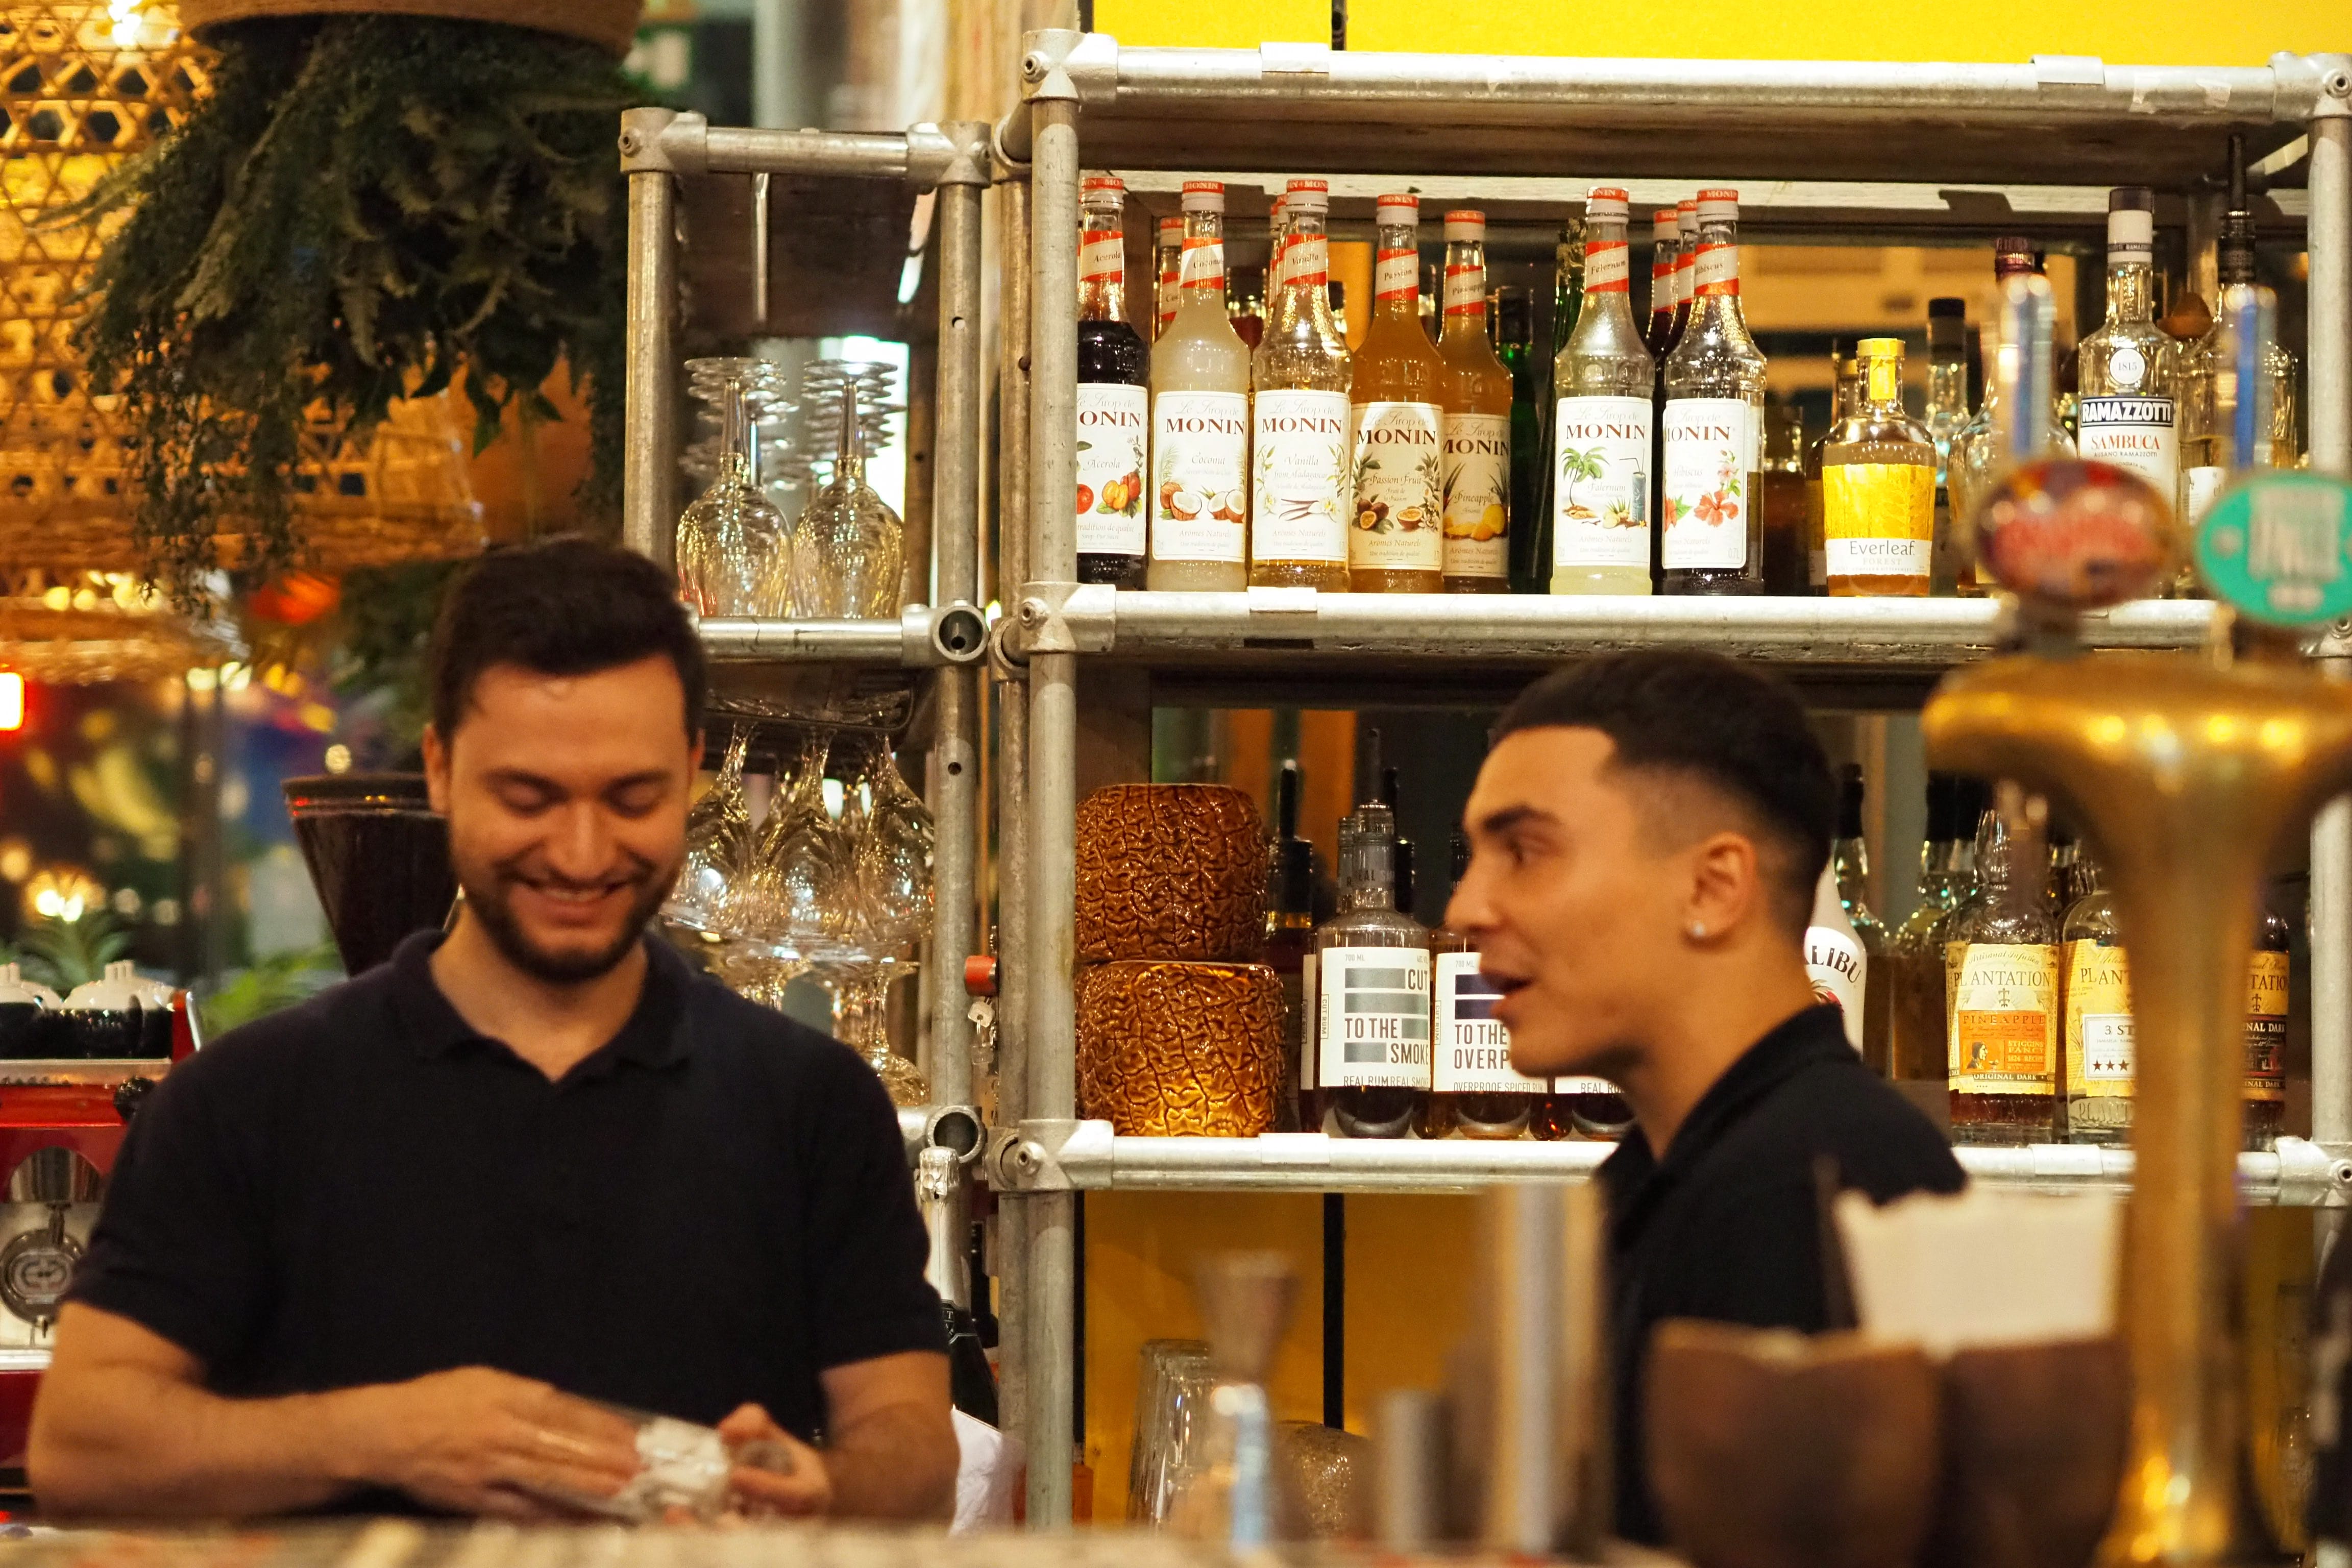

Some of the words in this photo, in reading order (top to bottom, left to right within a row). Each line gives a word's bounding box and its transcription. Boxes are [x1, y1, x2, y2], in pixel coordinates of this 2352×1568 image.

[1094, 251, 1121, 263] Acerola
[1292, 253, 1319, 265] Vanilla
[1384, 268, 1412, 281] Passion
[1590, 260, 1626, 275] Falernum
[1452, 283, 1484, 296] Pineapp
[2118, 362, 2137, 371] 1815
[1090, 392, 1121, 410] Sirop
[1269, 399, 1287, 414] Le
[1289, 398, 1320, 417] Sirop
[1324, 406, 1336, 414] de
[1175, 400, 1194, 414] Le
[1196, 400, 1227, 419] Sirop
[1229, 407, 1239, 415] de
[1574, 405, 1591, 421] Le
[1594, 404, 1626, 423] Sirop
[1629, 412, 1639, 421] de
[2082, 402, 2171, 422] RAMAZZOTTI
[1080, 410, 1141, 428] ONIN
[1166, 418, 1245, 435] MONIN
[1262, 417, 1342, 434] MONIN
[1365, 411, 1381, 426] Le
[1384, 410, 1415, 429] Sirop
[1418, 418, 1429, 426] de
[1357, 428, 1436, 446] MONIN
[1445, 422, 1464, 435] Le
[1466, 422, 1497, 439] Sirop
[1566, 423, 1645, 440] MONIN
[1667, 426, 1730, 442] ONIN
[1443, 439, 1509, 456] MONIN
[2091, 435, 2160, 450] SAMBUCA
[1083, 456, 1121, 471] Acerola
[1192, 452, 1226, 465] Coconut
[1284, 453, 1319, 466] Vanilla
[1273, 470, 1288, 480] from
[1288, 469, 1328, 481] Madagascar
[1674, 464, 1703, 476] Hibiscus
[1369, 472, 1399, 486] Passion
[1401, 471, 1423, 486] Fruit
[1587, 482, 1626, 493] Falernum
[1454, 490, 1494, 506] Pineapple
[1077, 522, 1106, 532] tradition
[1394, 539, 1421, 548] Naturels
[1863, 557, 1902, 566] FOREST
[1809, 945, 1861, 983] LIBU
[1969, 950, 2006, 964] Artisanal
[2007, 951, 2040, 965] Infusion
[1408, 969, 1428, 991] CUT
[1954, 971, 2050, 987] PLANTATION
[2080, 967, 2130, 985] PLANT
[2251, 974, 2288, 991] TATIO
[1963, 1015, 2046, 1024] PINEAPPLE
[2245, 1022, 2265, 1032] NAL
[1344, 1018, 1364, 1039] TO
[1369, 1018, 1398, 1039] THE
[1455, 1024, 1473, 1044] TO
[1477, 1024, 1508, 1045] THE
[2104, 1025, 2111, 1035] 3
[2117, 1024, 2135, 1036] ST
[1390, 1043, 1429, 1065] SMOKE
[1454, 1049, 1510, 1069] OVERP
[1344, 1075, 1364, 1087] REAL
[1368, 1075, 1388, 1087] RUM
[1390, 1076, 1409, 1087] REAL
[1454, 1082, 1502, 1092] OVERPROOF
[1504, 1082, 1531, 1092] SPICED
[1581, 1083, 1601, 1093] REAL
[1607, 1083, 1621, 1093] RU
